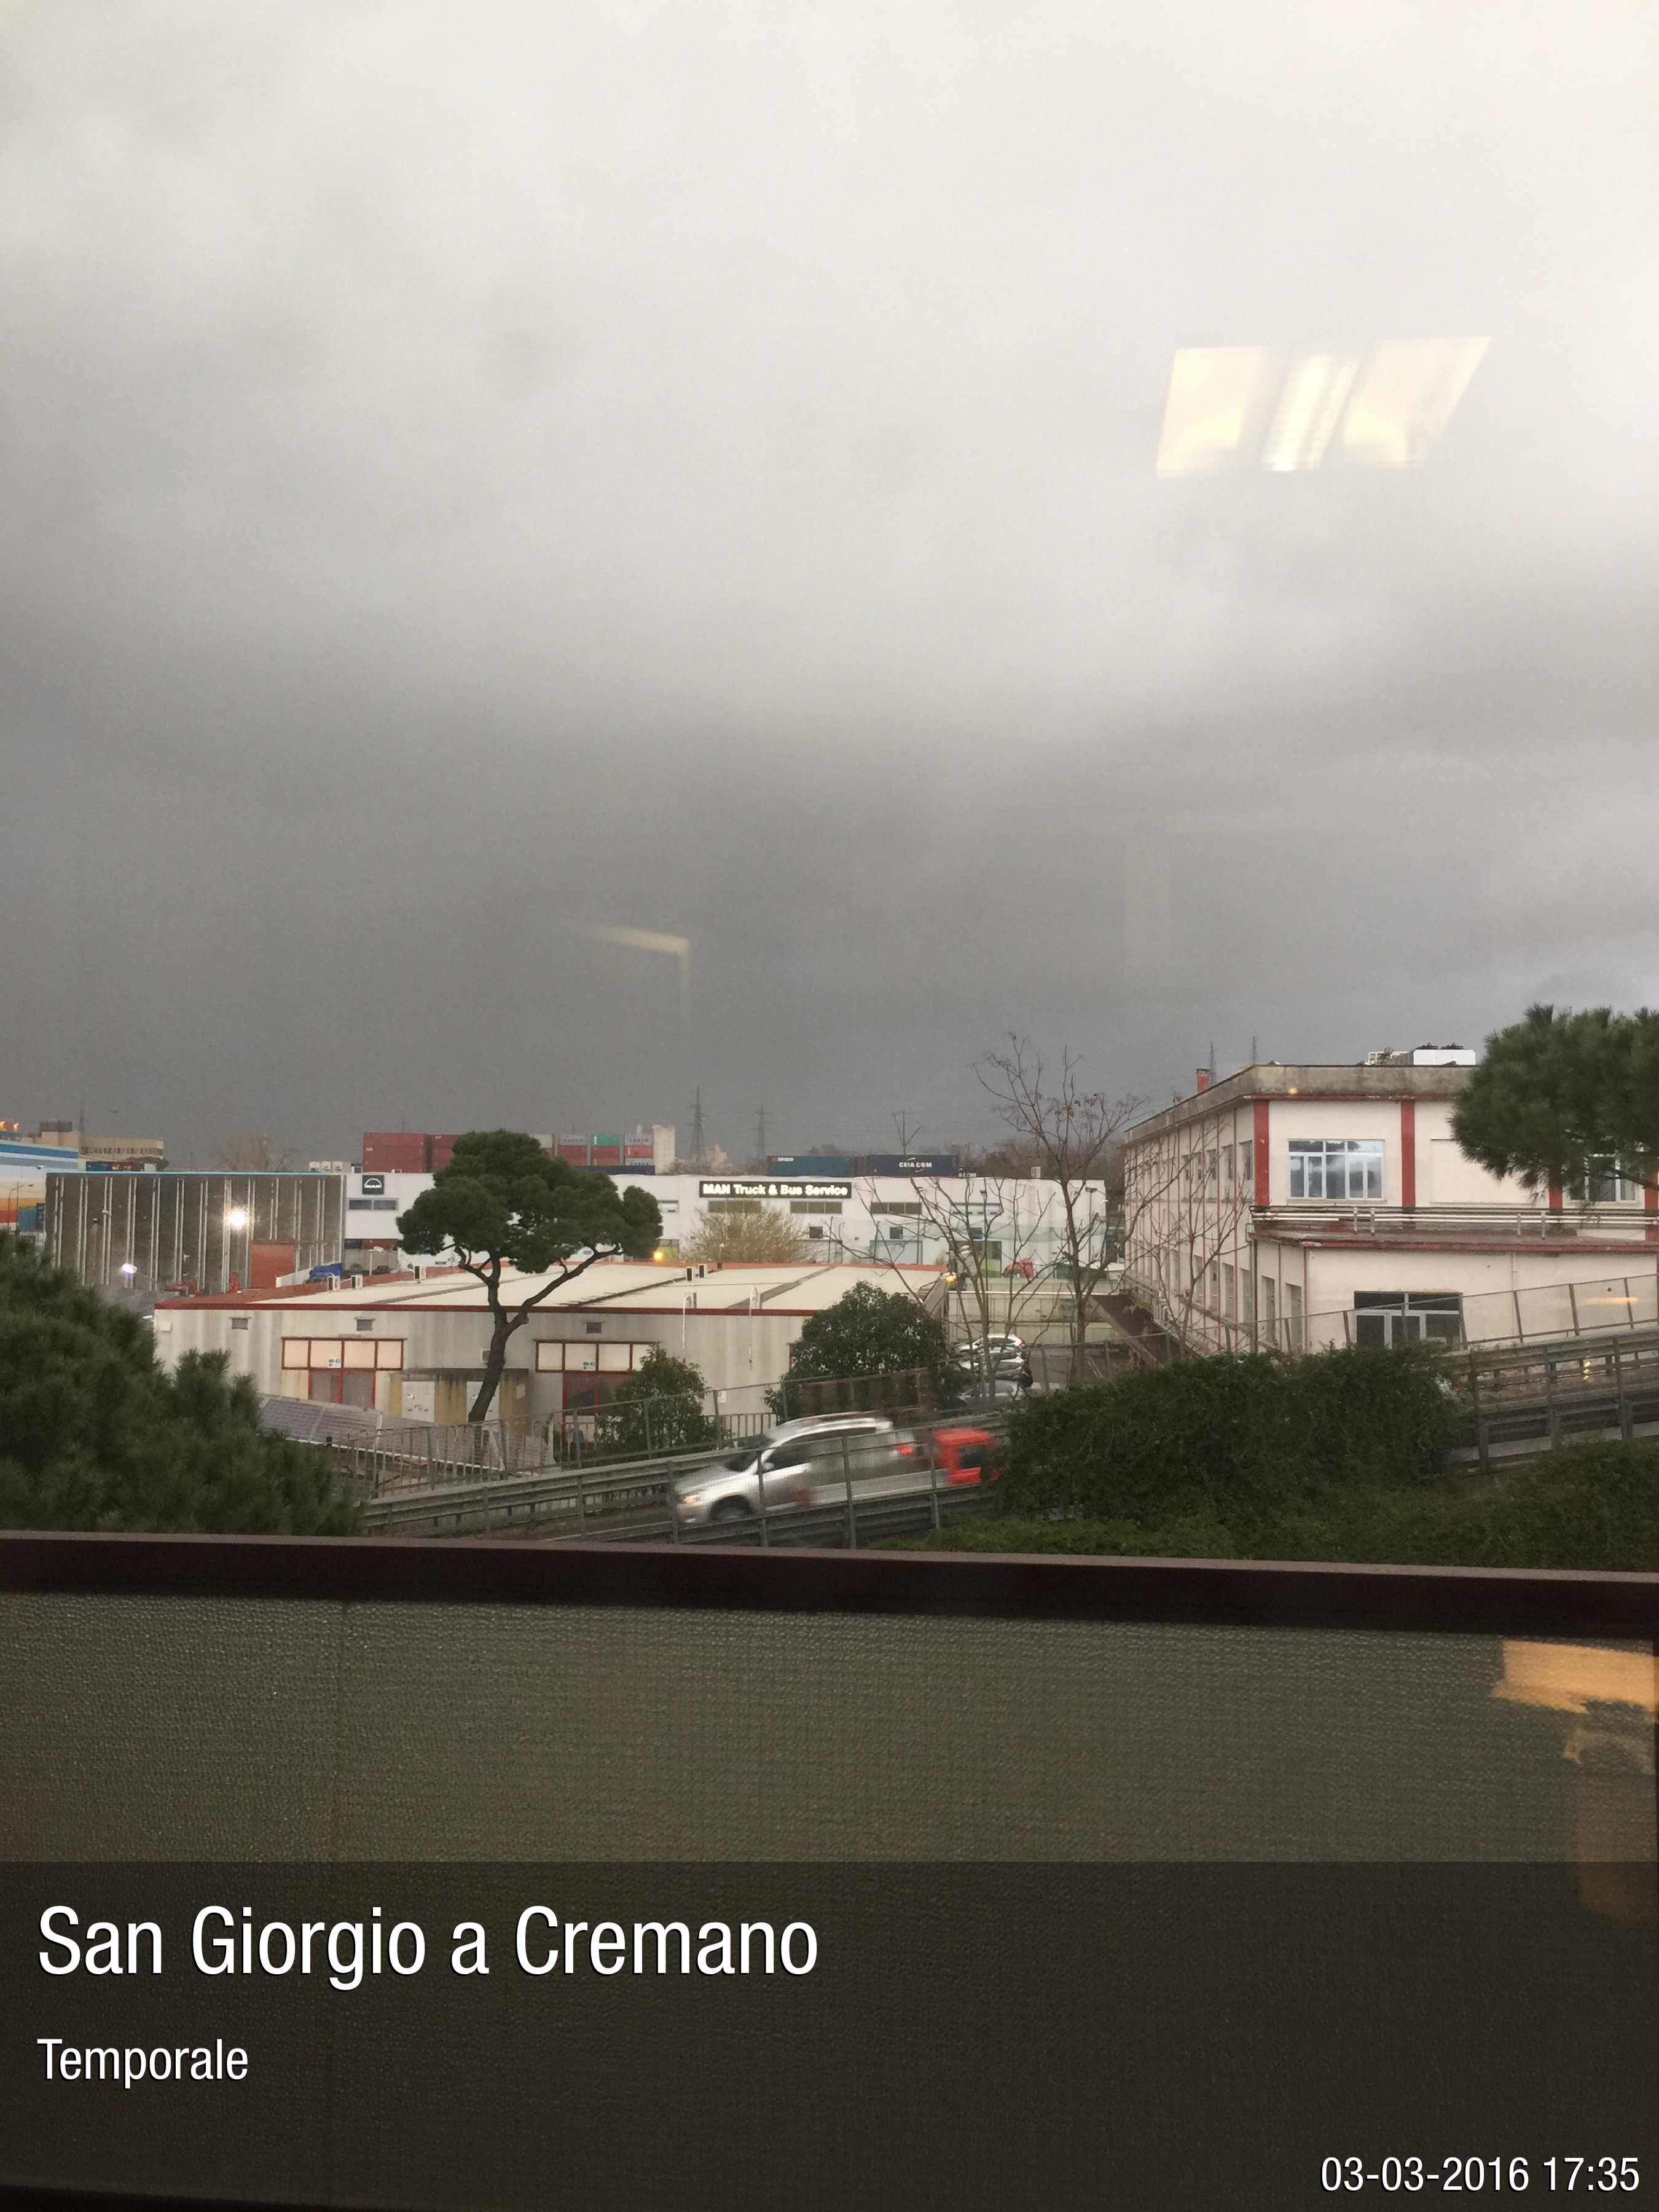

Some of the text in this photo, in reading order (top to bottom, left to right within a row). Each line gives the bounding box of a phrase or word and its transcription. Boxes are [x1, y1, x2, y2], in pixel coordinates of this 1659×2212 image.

[703, 1184, 849, 1196] MAN Truck & Bus Service
